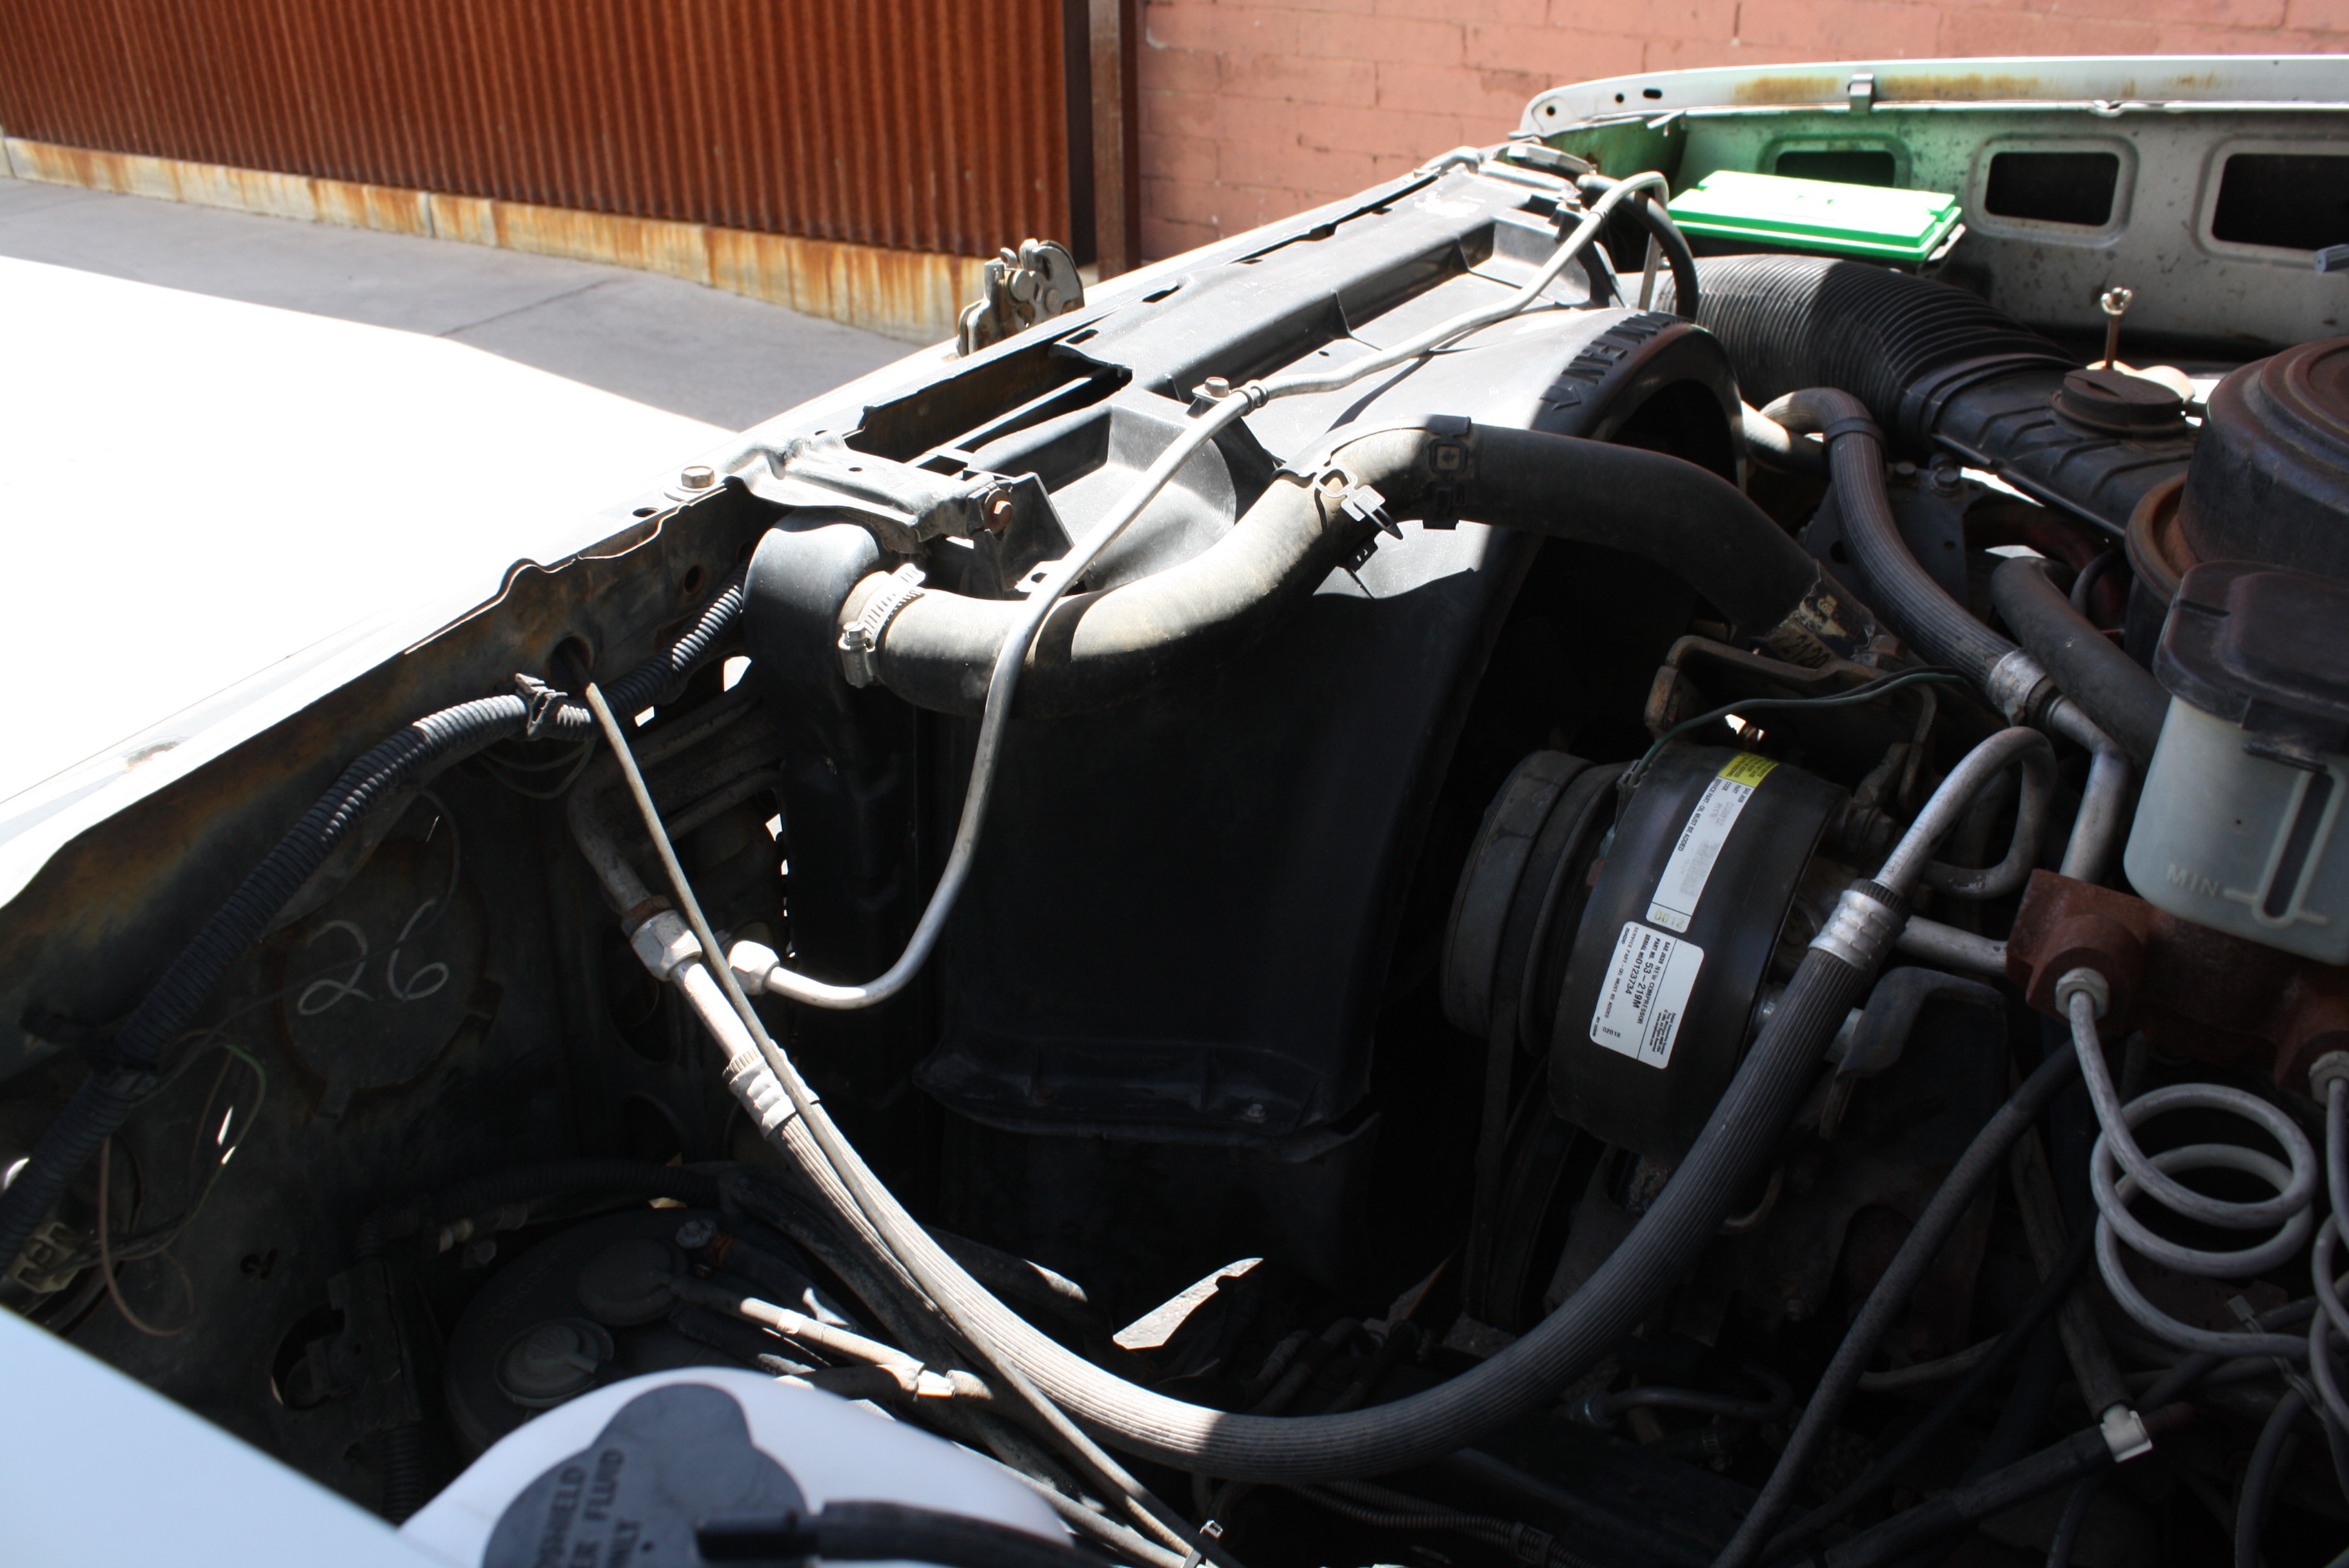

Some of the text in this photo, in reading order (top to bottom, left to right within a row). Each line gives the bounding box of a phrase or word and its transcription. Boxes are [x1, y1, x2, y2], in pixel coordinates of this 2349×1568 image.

[1703, 792, 1713, 803] PART
[1691, 812, 1701, 827] MUST
[1677, 833, 1690, 852] ADDED
[2165, 862, 2221, 898] MIN
[1627, 927, 1638, 948] SERVICE
[1640, 934, 1651, 950] SERIAL
[297, 895, 450, 1016] 26
[1652, 966, 1661, 980] NEW
[1604, 1002, 1612, 1018] ADDED
[1637, 982, 1654, 1024] COMPRESSOR
